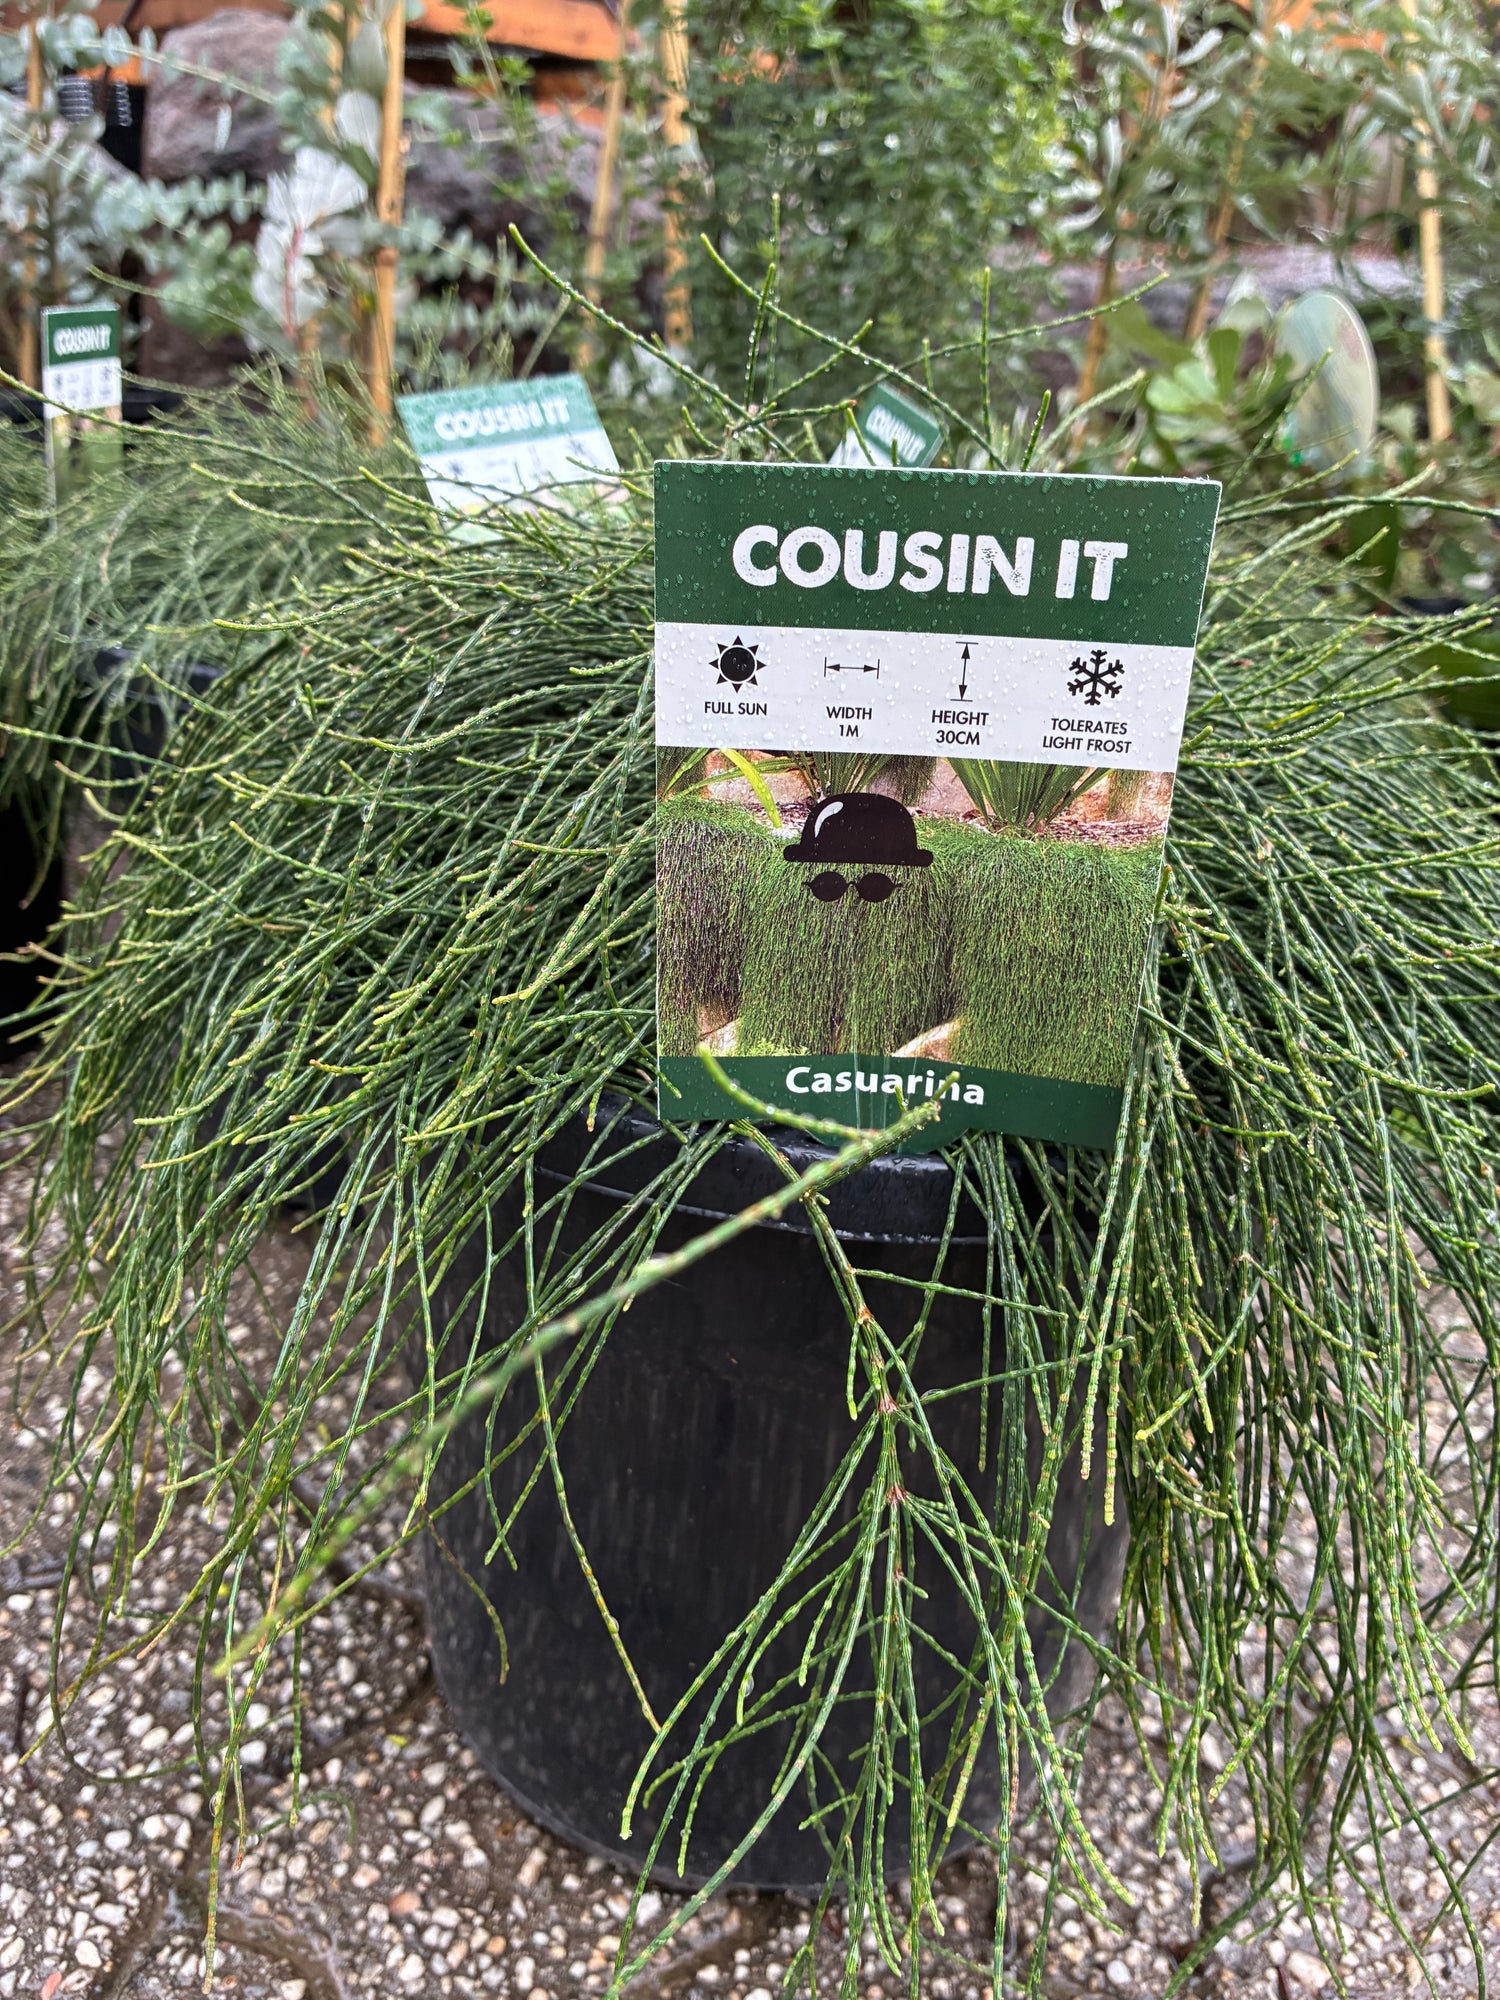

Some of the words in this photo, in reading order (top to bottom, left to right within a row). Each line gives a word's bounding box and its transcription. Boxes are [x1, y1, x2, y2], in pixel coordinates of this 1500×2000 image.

[732, 525, 1034, 596] COUSIN
[1055, 539, 1128, 601] IT
[704, 701, 735, 717] FULL
[738, 702, 768, 717] SUN
[826, 706, 873, 721] WIDTH
[931, 710, 989, 727] HEIGHT
[1050, 718, 1128, 736] TOLERATES
[839, 725, 860, 738] 1M
[935, 730, 981, 746] 30CM
[1042, 735, 1084, 752] LIGHT
[1086, 737, 1132, 754] FROST
[785, 1066, 985, 1106] Casuarina
